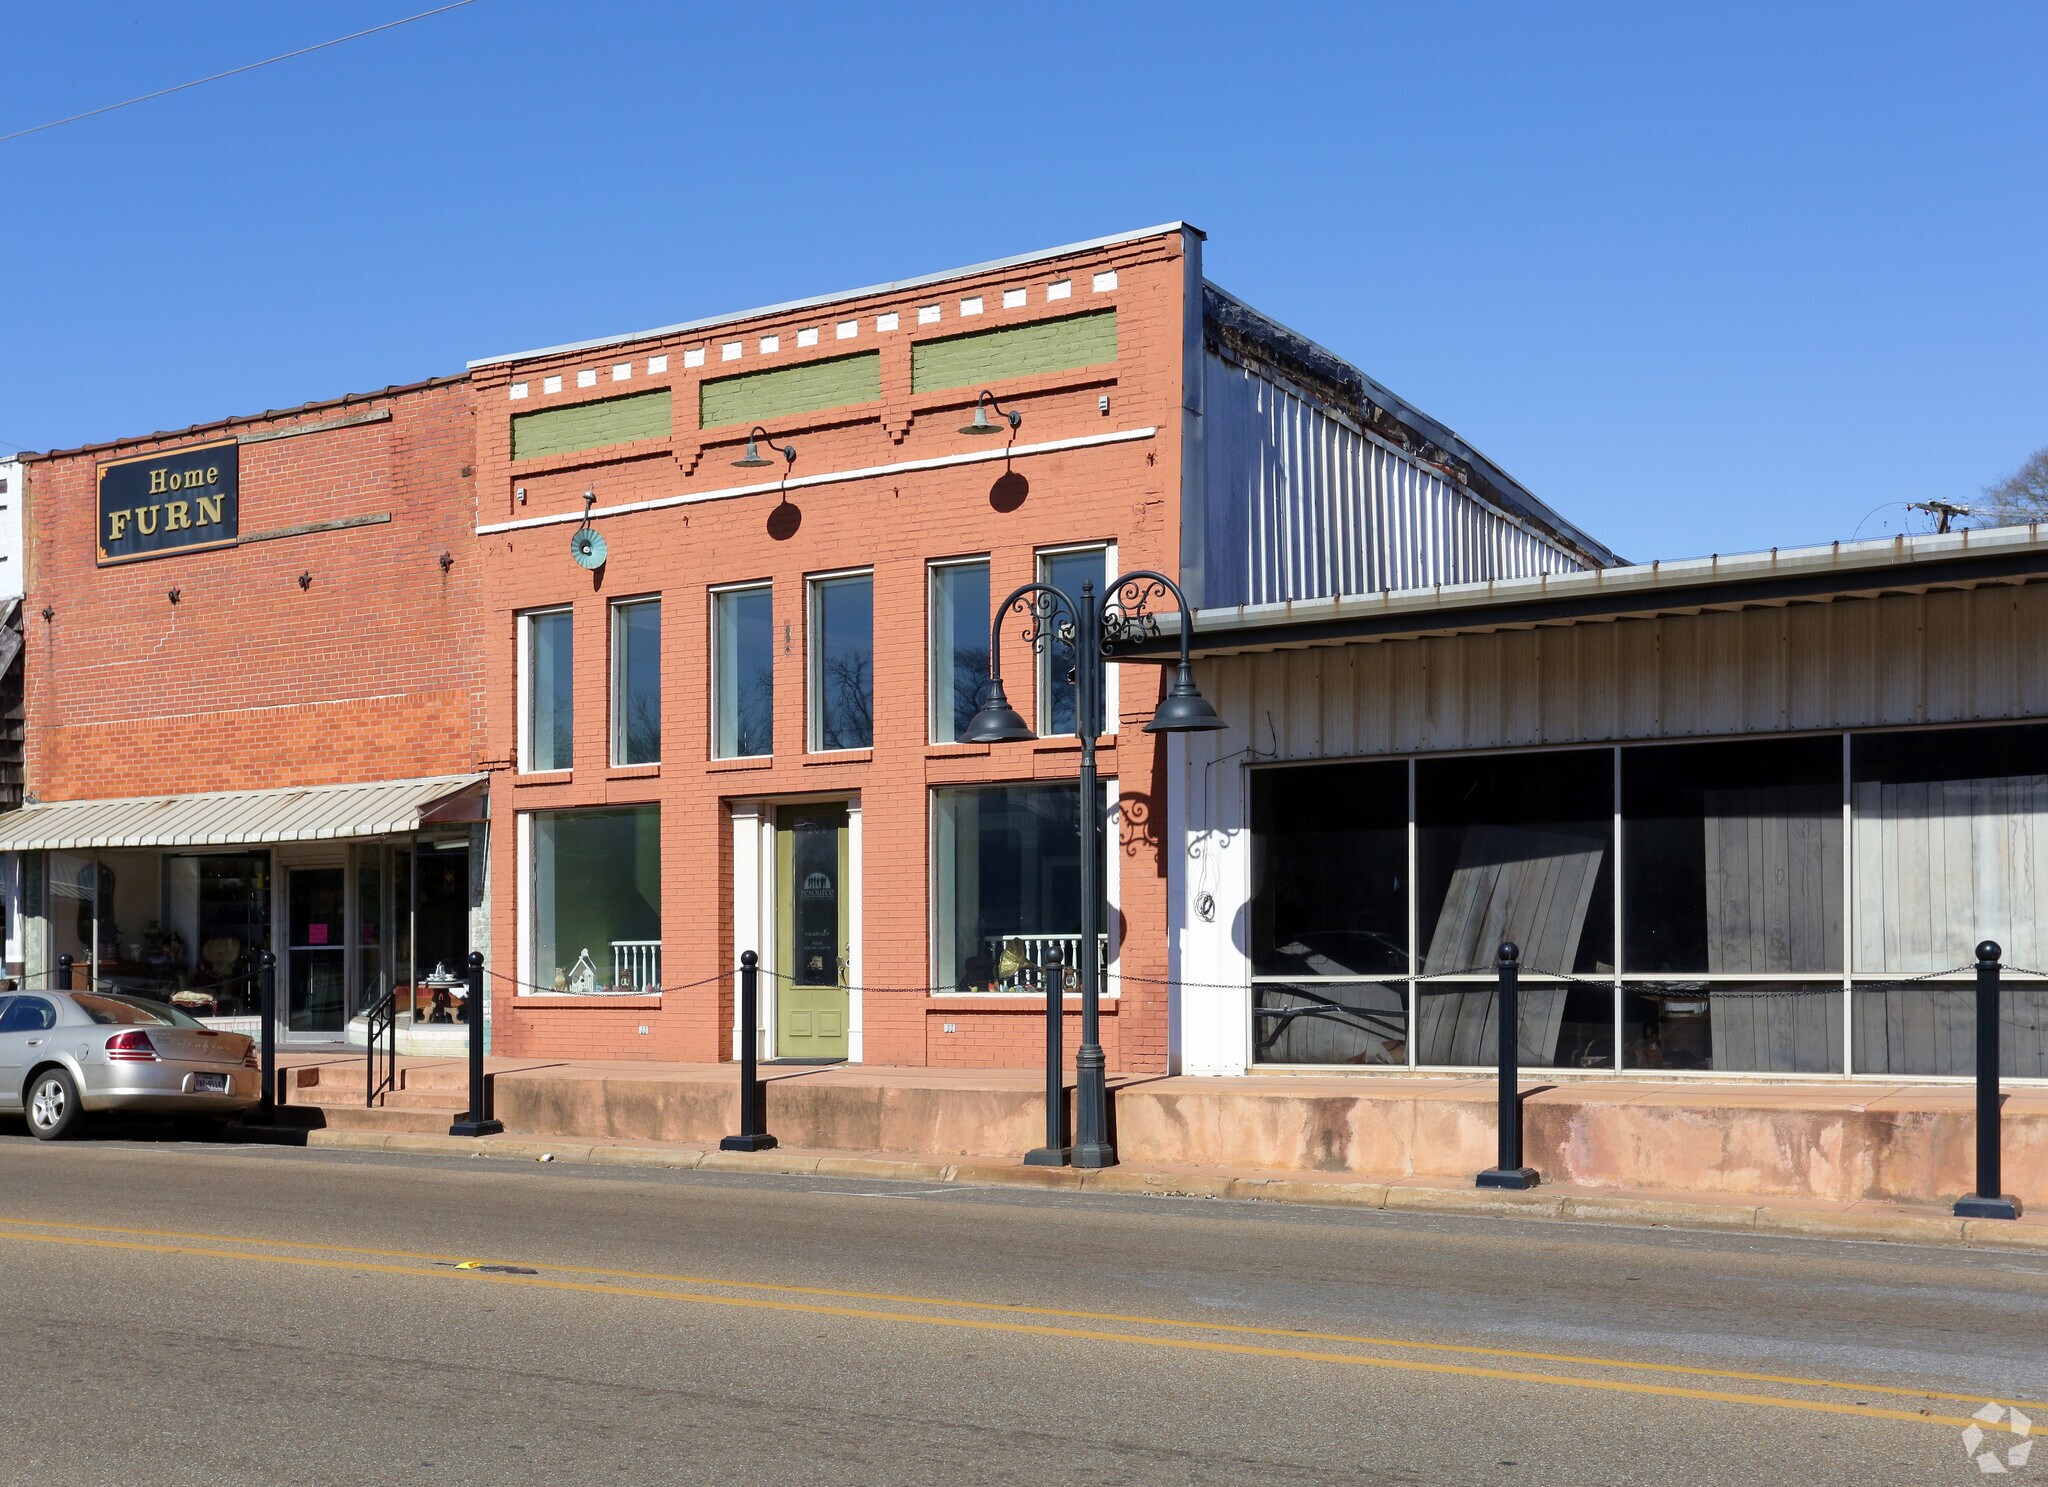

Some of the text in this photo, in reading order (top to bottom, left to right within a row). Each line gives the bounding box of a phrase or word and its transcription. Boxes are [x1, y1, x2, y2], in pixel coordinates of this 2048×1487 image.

[149, 466, 219, 494] Home
[109, 493, 225, 540] FURN
[807, 824, 827, 834] 206
[801, 888, 835, 897] resource
